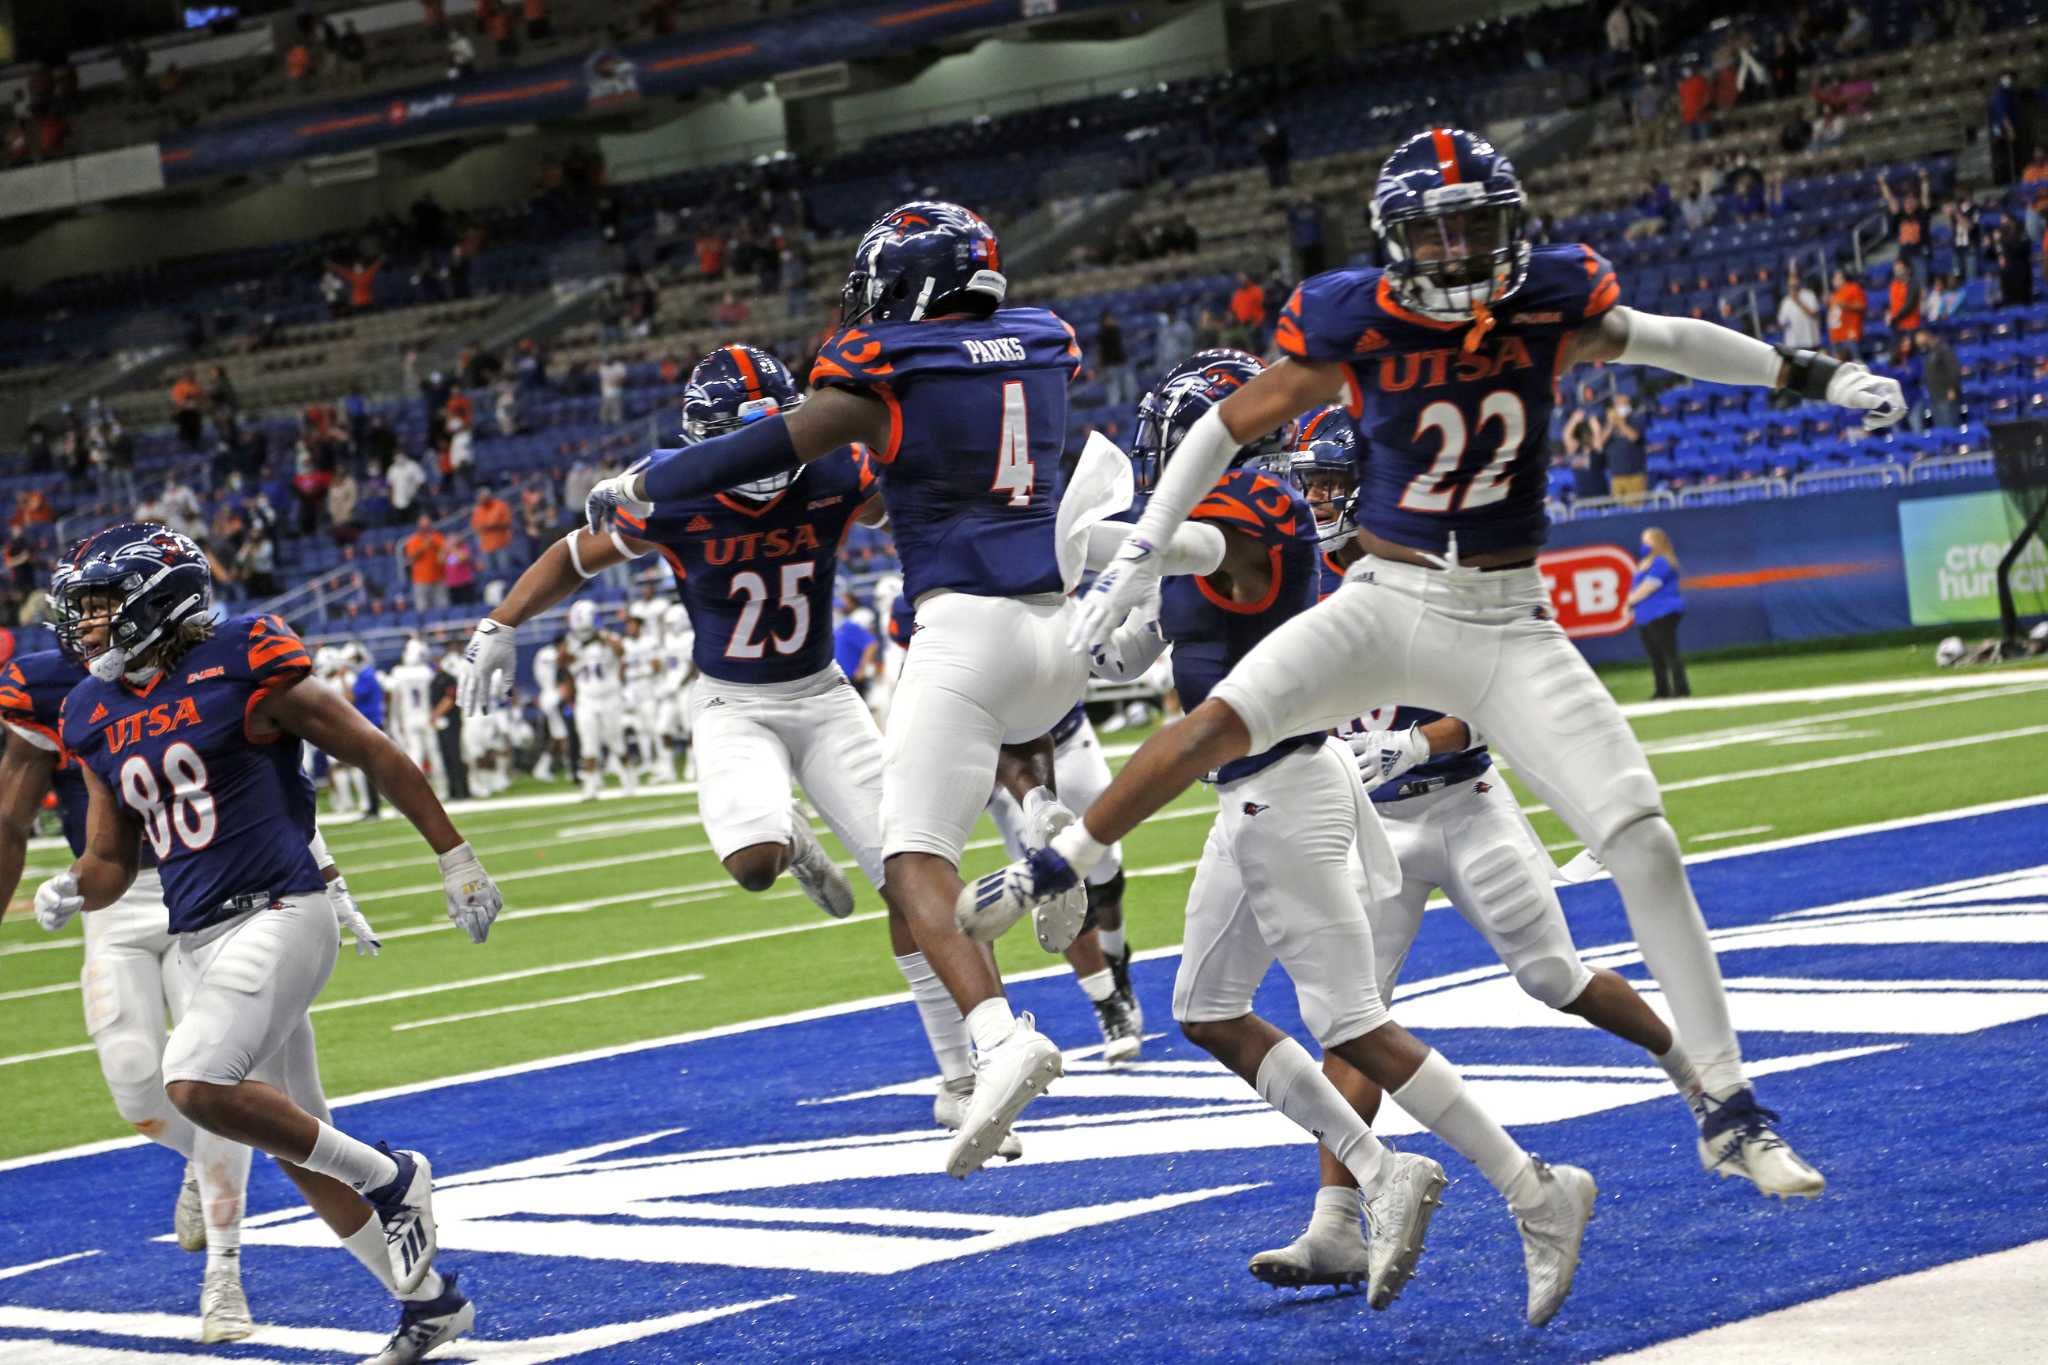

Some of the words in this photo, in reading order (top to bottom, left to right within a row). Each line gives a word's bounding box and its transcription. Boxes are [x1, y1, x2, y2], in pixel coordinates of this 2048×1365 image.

[962, 337, 1026, 364] PARKS
[1378, 335, 1533, 392] UTSA
[991, 380, 1035, 507] 4
[1397, 390, 1526, 513] 22
[703, 523, 821, 566] UTSA
[724, 561, 816, 660] 25
[103, 696, 203, 755] UTSA
[121, 741, 218, 861] 88
